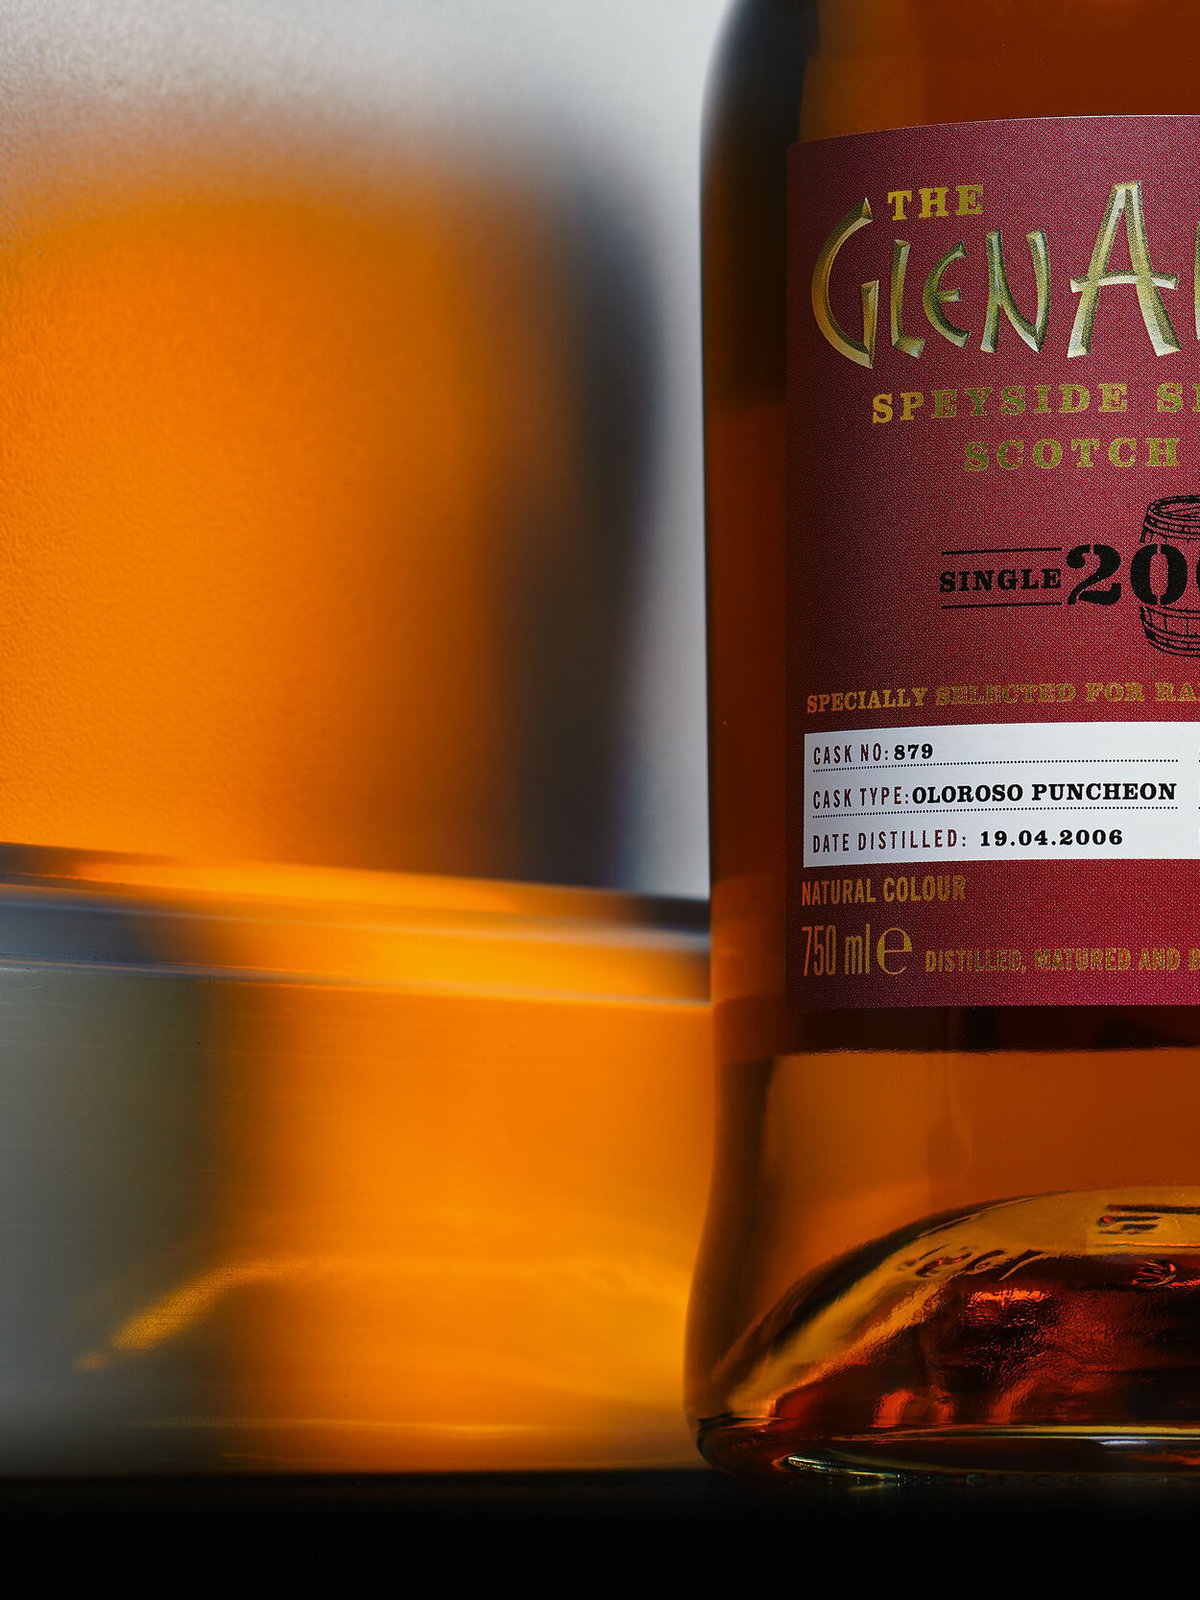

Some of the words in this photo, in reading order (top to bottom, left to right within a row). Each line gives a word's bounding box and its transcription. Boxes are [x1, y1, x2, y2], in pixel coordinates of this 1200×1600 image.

[887, 184, 984, 222] THE
[872, 383, 1127, 424] SPEYSIDE
[965, 437, 1180, 471] SCOTCH
[939, 567, 1061, 594] SINGLE
[806, 687, 928, 713] SPECIALLY
[935, 683, 1075, 705] SELECTED
[1086, 682, 1145, 703] FOR
[813, 746, 852, 765] CASK
[860, 744, 889, 763] NO:
[893, 743, 934, 761] 879
[813, 788, 852, 810] CASK
[860, 785, 909, 806] TYPE:
[911, 784, 1023, 804] OLOROSO
[1031, 782, 1177, 801] PUNCHEON
[813, 833, 849, 854] DATE
[858, 828, 967, 852] DISTILLED:
[980, 829, 1123, 847] 19.04.2006
[802, 879, 876, 906] NATURAL
[883, 875, 967, 903] COLOUR
[802, 924, 837, 977] 750
[844, 923, 870, 975] ml
[925, 949, 1026, 974] DISTILLED,
[1035, 948, 1131, 972] MATURED
[1138, 948, 1181, 972] AND
